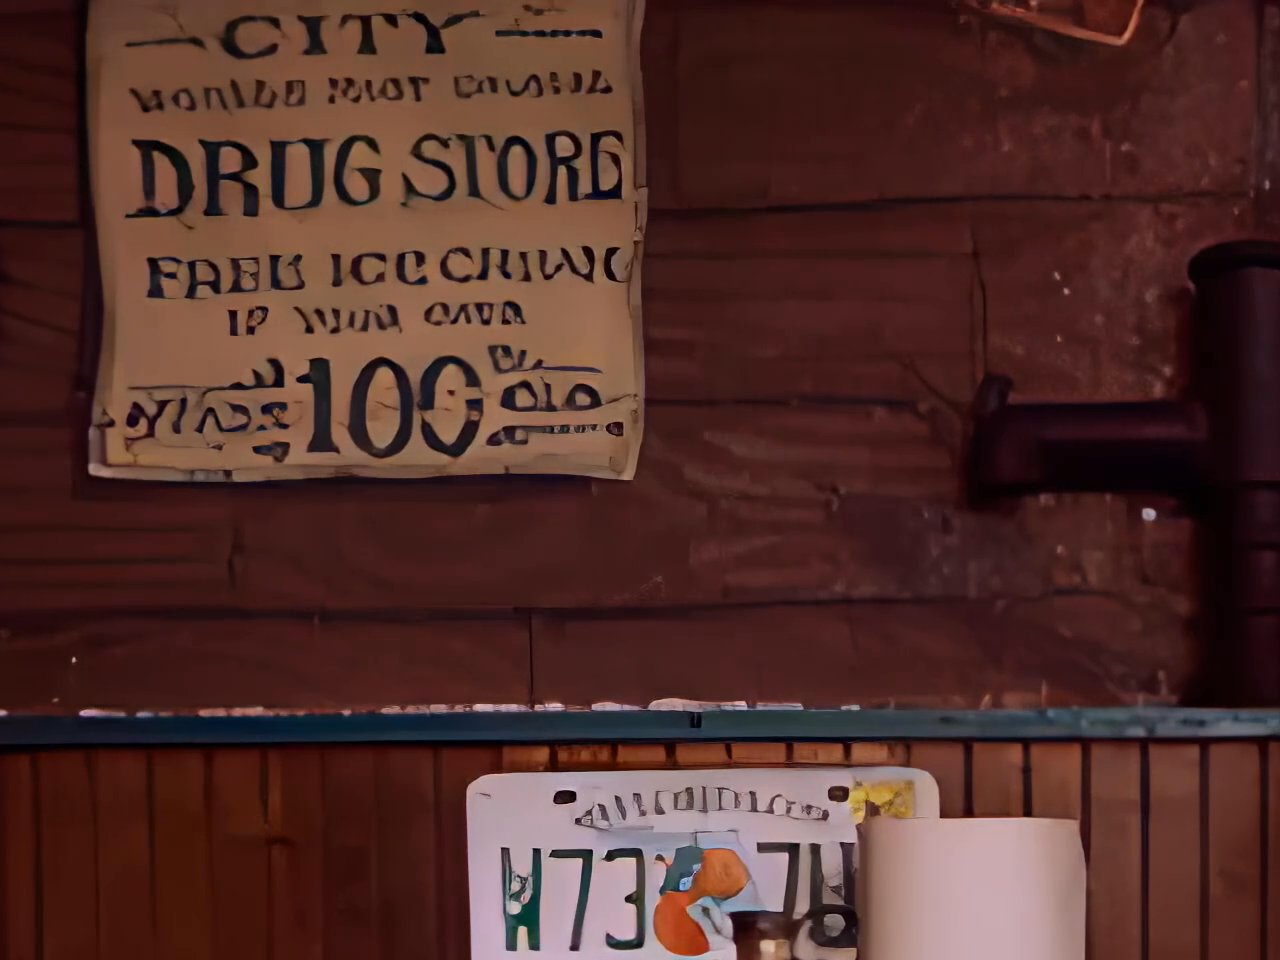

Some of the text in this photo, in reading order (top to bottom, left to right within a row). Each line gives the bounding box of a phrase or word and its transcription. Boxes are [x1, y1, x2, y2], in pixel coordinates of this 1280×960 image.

[221, 11, 480, 59] CITY
[126, 135, 382, 217] DRUG
[297, 355, 484, 459] 100
